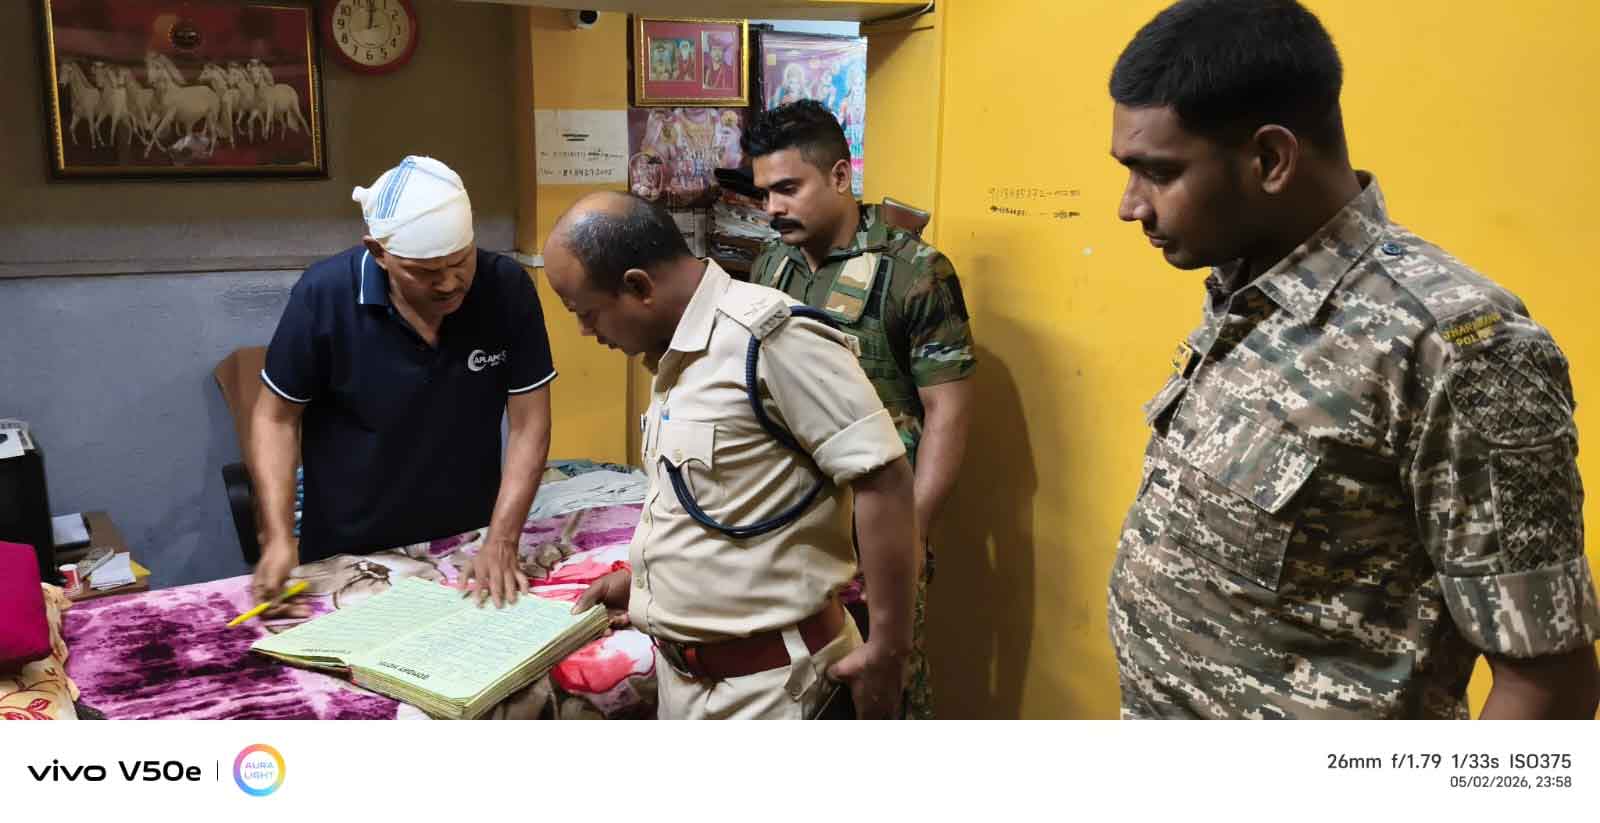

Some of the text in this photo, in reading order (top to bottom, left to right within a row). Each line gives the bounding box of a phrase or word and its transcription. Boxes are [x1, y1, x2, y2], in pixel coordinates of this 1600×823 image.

[340, 5, 352, 17] 10
[336, 18, 345, 30] 9
[390, 37, 397, 49] 4
[352, 44, 359, 56] 7
[366, 50, 374, 61] 6
